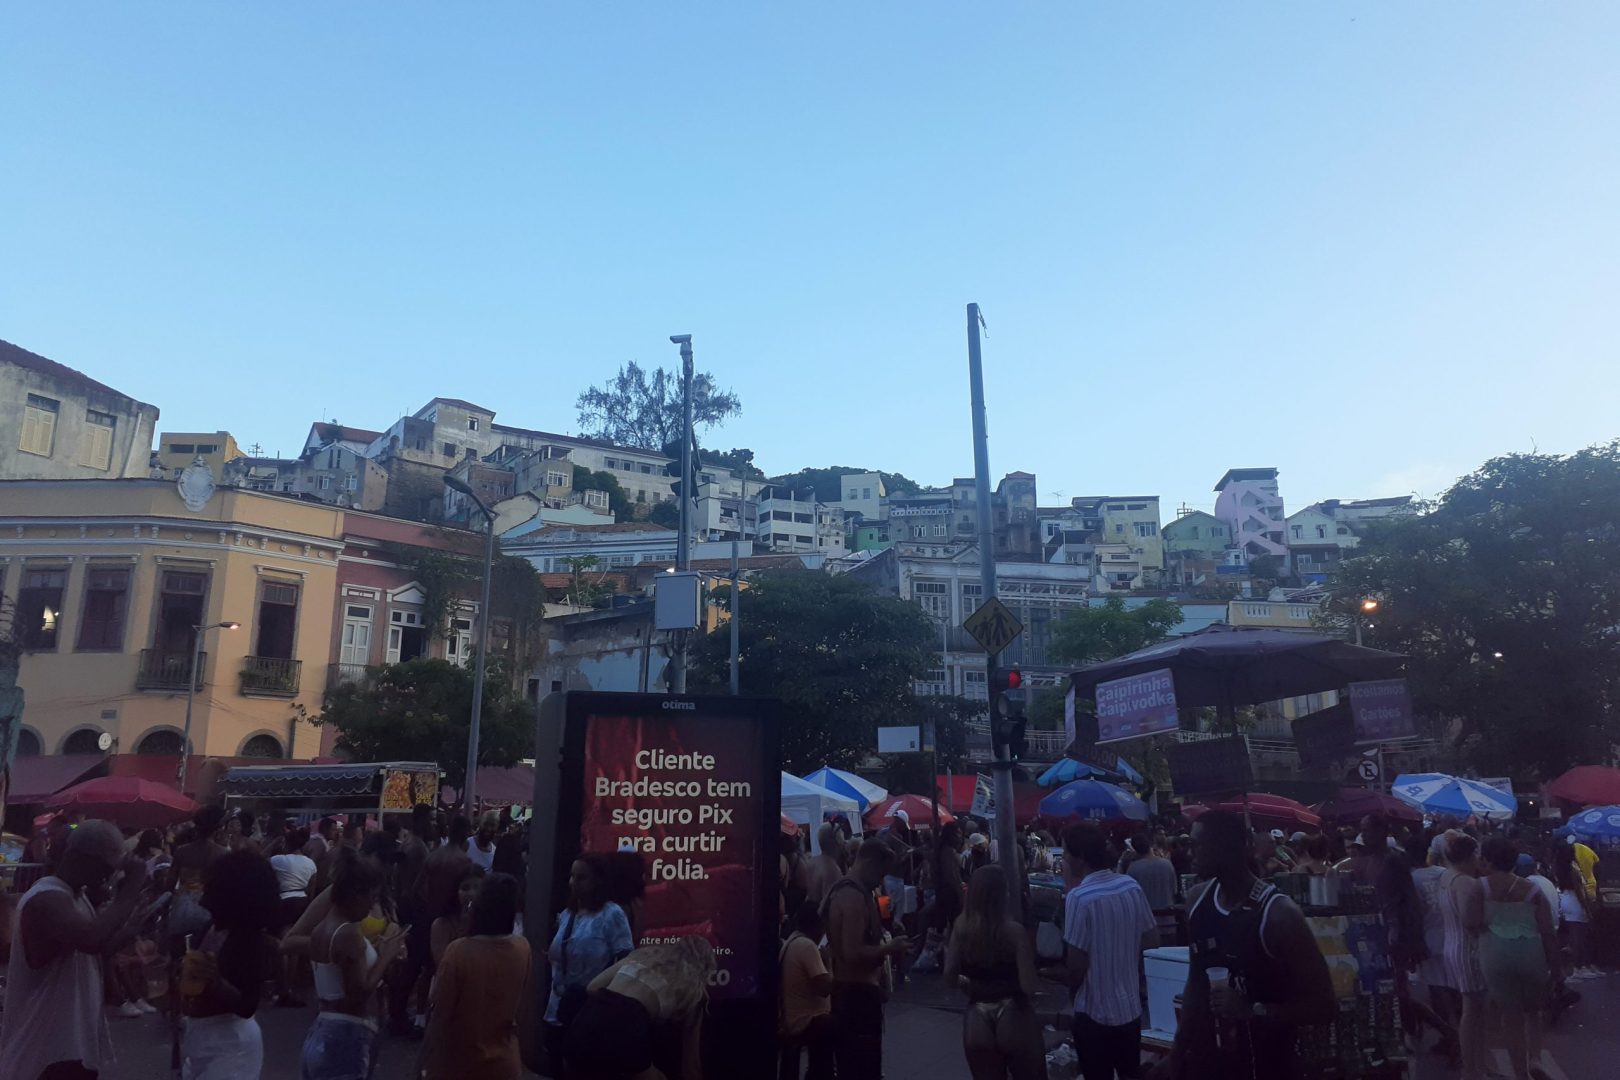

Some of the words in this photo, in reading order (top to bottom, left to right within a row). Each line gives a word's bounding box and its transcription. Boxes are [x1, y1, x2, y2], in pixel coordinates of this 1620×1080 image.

[1096, 677, 1170, 702] Caipirinha
[635, 749, 716, 771] Cliente
[595, 776, 701, 797] Bradesco
[707, 778, 751, 797] tem
[611, 807, 693, 830] seguro
[699, 803, 733, 824] Pix
[662, 830, 726, 852] curtir
[652, 858, 710, 880] folia.
[639, 936, 661, 945] ntre
